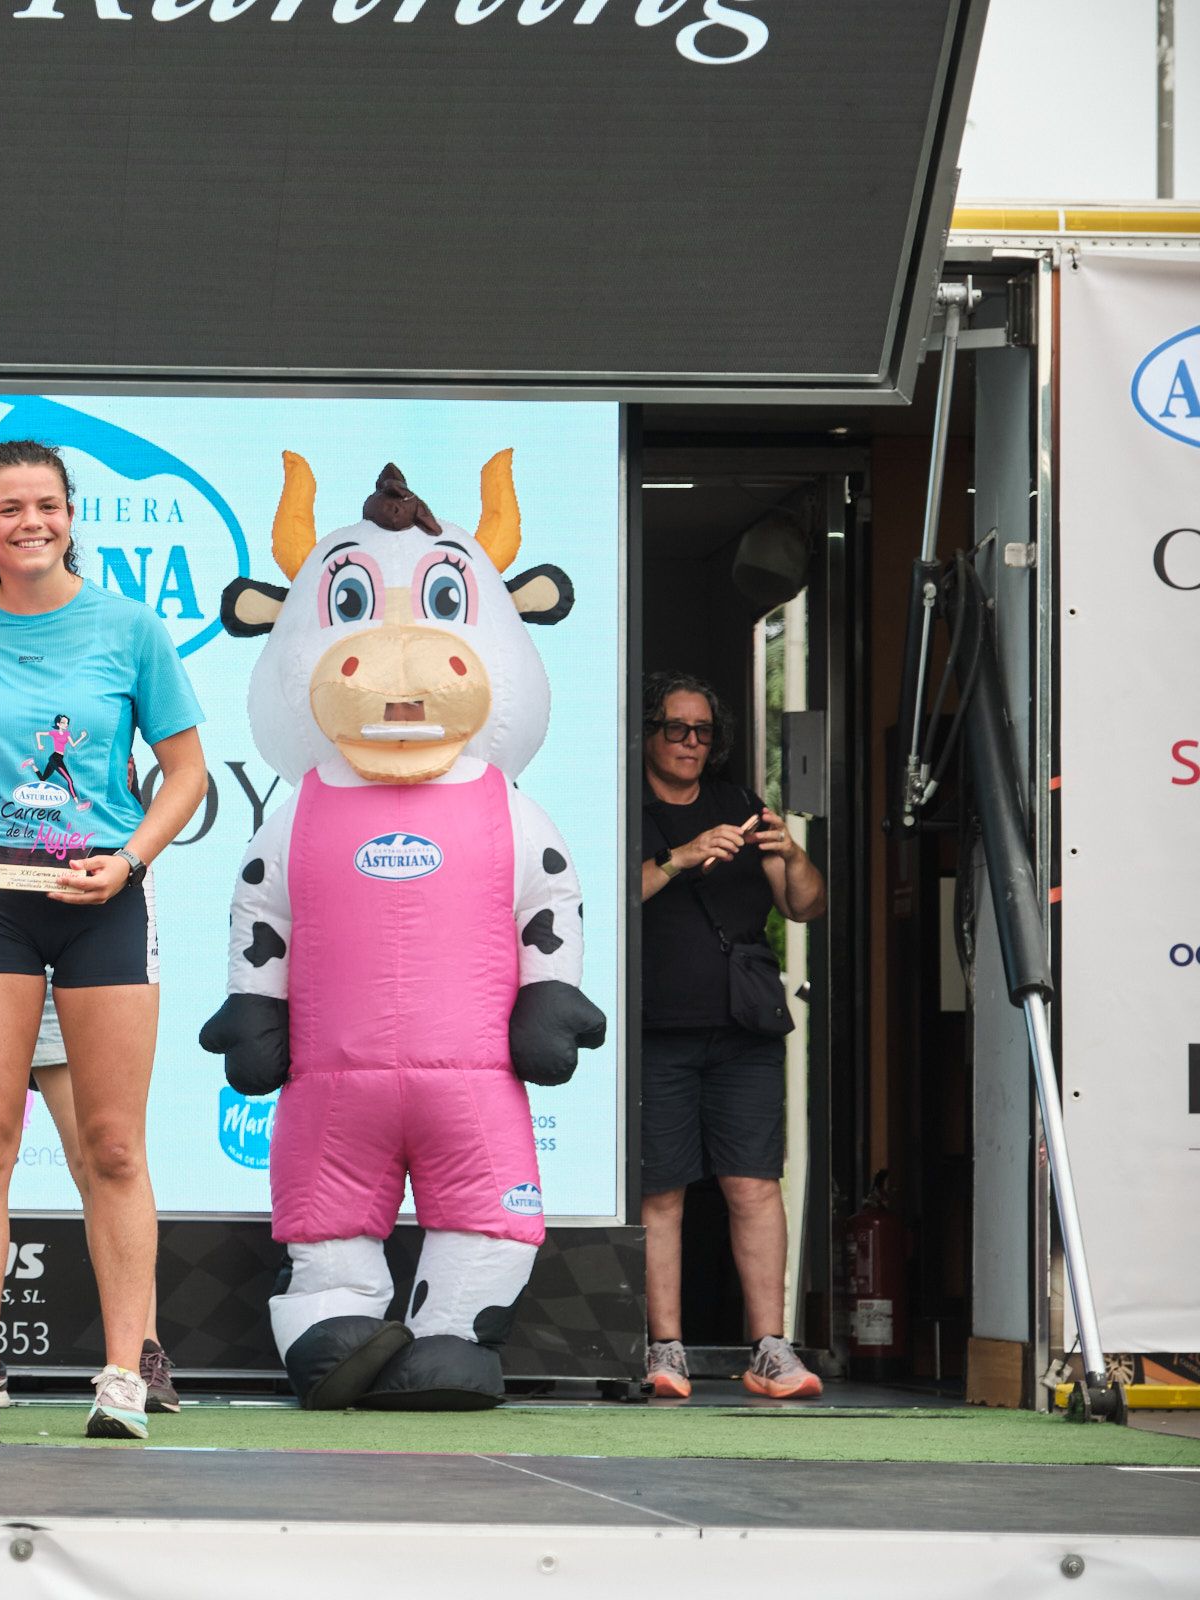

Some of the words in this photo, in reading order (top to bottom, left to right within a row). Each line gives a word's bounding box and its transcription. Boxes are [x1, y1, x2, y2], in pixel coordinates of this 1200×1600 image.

[19, 791, 63, 802] ASTURIANA
[1, 802, 61, 821] Carrera
[6, 822, 19, 837] de
[24, 822, 34, 838] la
[31, 821, 95, 860] Mujer
[362, 851, 435, 868] ASTURIANA
[21, 1289, 46, 1303] SL.
